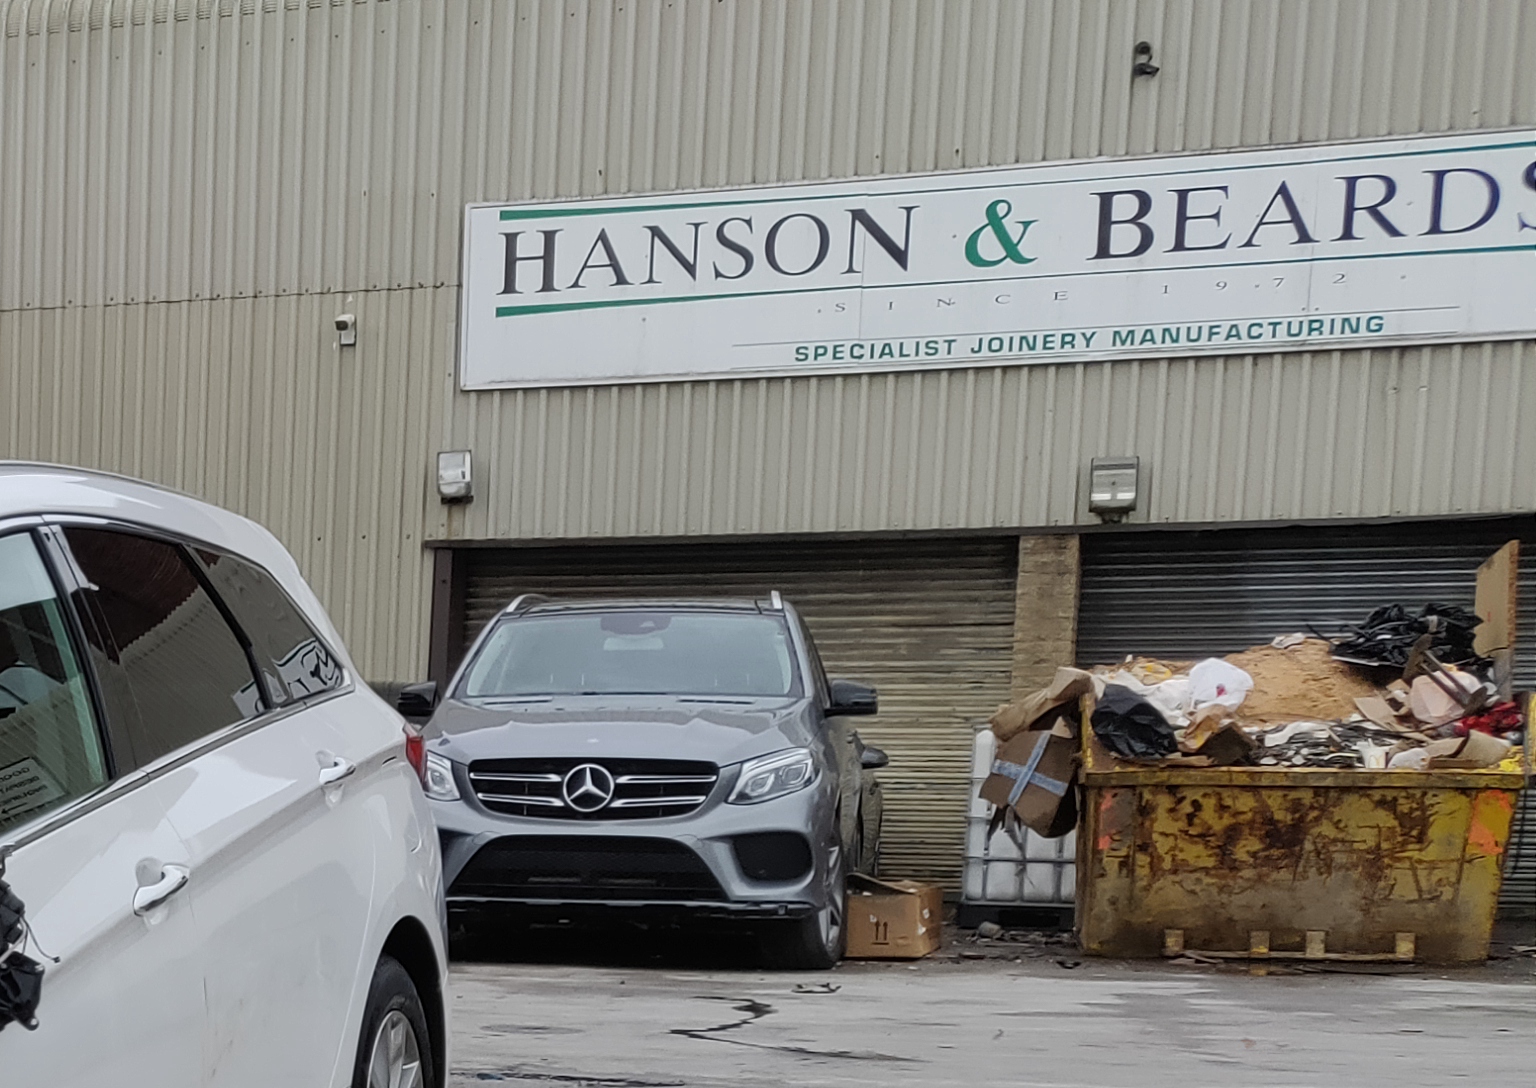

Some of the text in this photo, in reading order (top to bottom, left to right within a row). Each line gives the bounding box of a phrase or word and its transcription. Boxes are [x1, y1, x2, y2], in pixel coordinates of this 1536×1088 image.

[496, 205, 921, 296] HANSON
[965, 199, 1040, 268] &
[834, 273, 1346, 313] SINCE 1972
[794, 315, 1385, 363] SPECIALIST JOINERY MANUFACTURING
